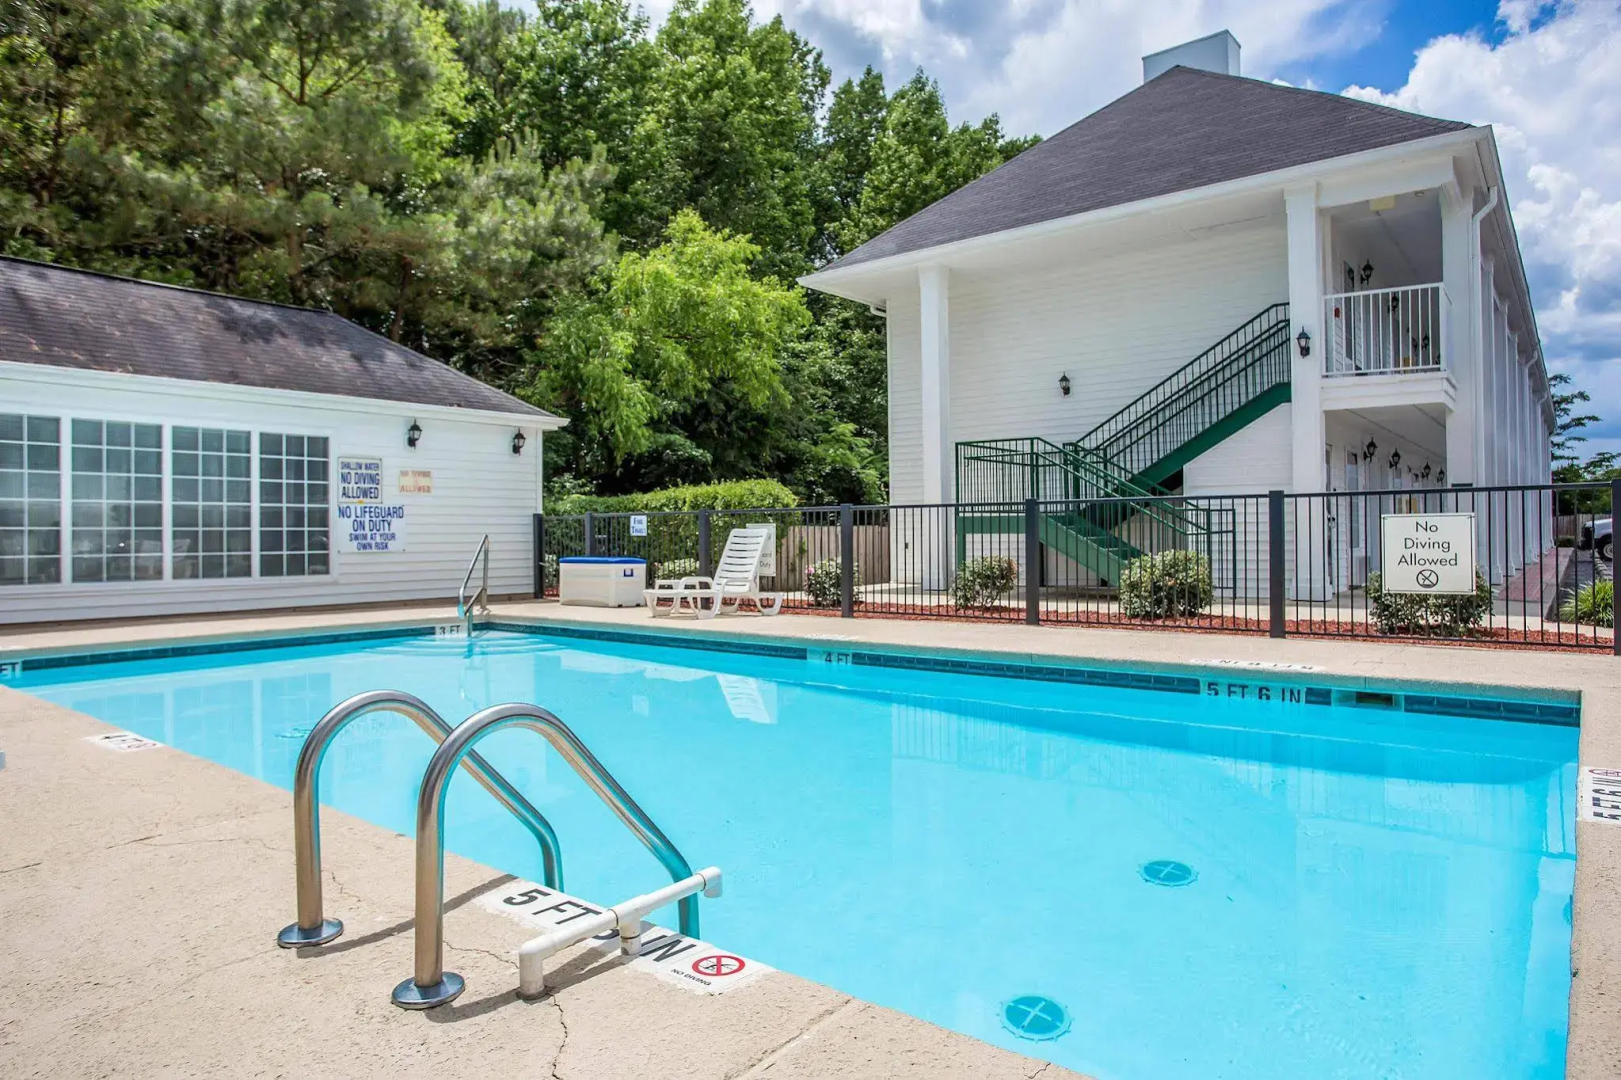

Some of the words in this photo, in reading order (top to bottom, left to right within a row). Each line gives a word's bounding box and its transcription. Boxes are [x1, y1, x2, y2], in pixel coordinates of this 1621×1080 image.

[341, 461, 362, 470] SHALLOW
[365, 462, 379, 471] WATER
[341, 472, 352, 484] NO
[354, 472, 380, 485] DIVING
[341, 486, 379, 499] ALLOWED
[338, 506, 352, 518] NO
[355, 506, 404, 518] LIFEGUARD
[353, 519, 365, 532] ON
[369, 519, 392, 531] DUTY
[1415, 521, 1438, 533] No
[349, 533, 367, 542] SWIM
[370, 533, 377, 541] AT
[379, 533, 396, 541] YOUR
[356, 542, 372, 551] OWN
[374, 542, 389, 550] RISK
[1404, 537, 1451, 553] Diving
[1398, 553, 1458, 566] Allowed
[440, 626, 446, 635] 3
[450, 625, 461, 634] FT
[825, 652, 832, 663] 4
[837, 653, 850, 665] FT
[1207, 682, 1219, 697] 5
[1227, 683, 1249, 699] FT
[1258, 686, 1271, 701] 6
[1281, 688, 1301, 704] IN
[503, 888, 552, 906] 5
[531, 900, 603, 925] FT
[639, 934, 697, 962] IN
[684, 973, 711, 986] DIVING
